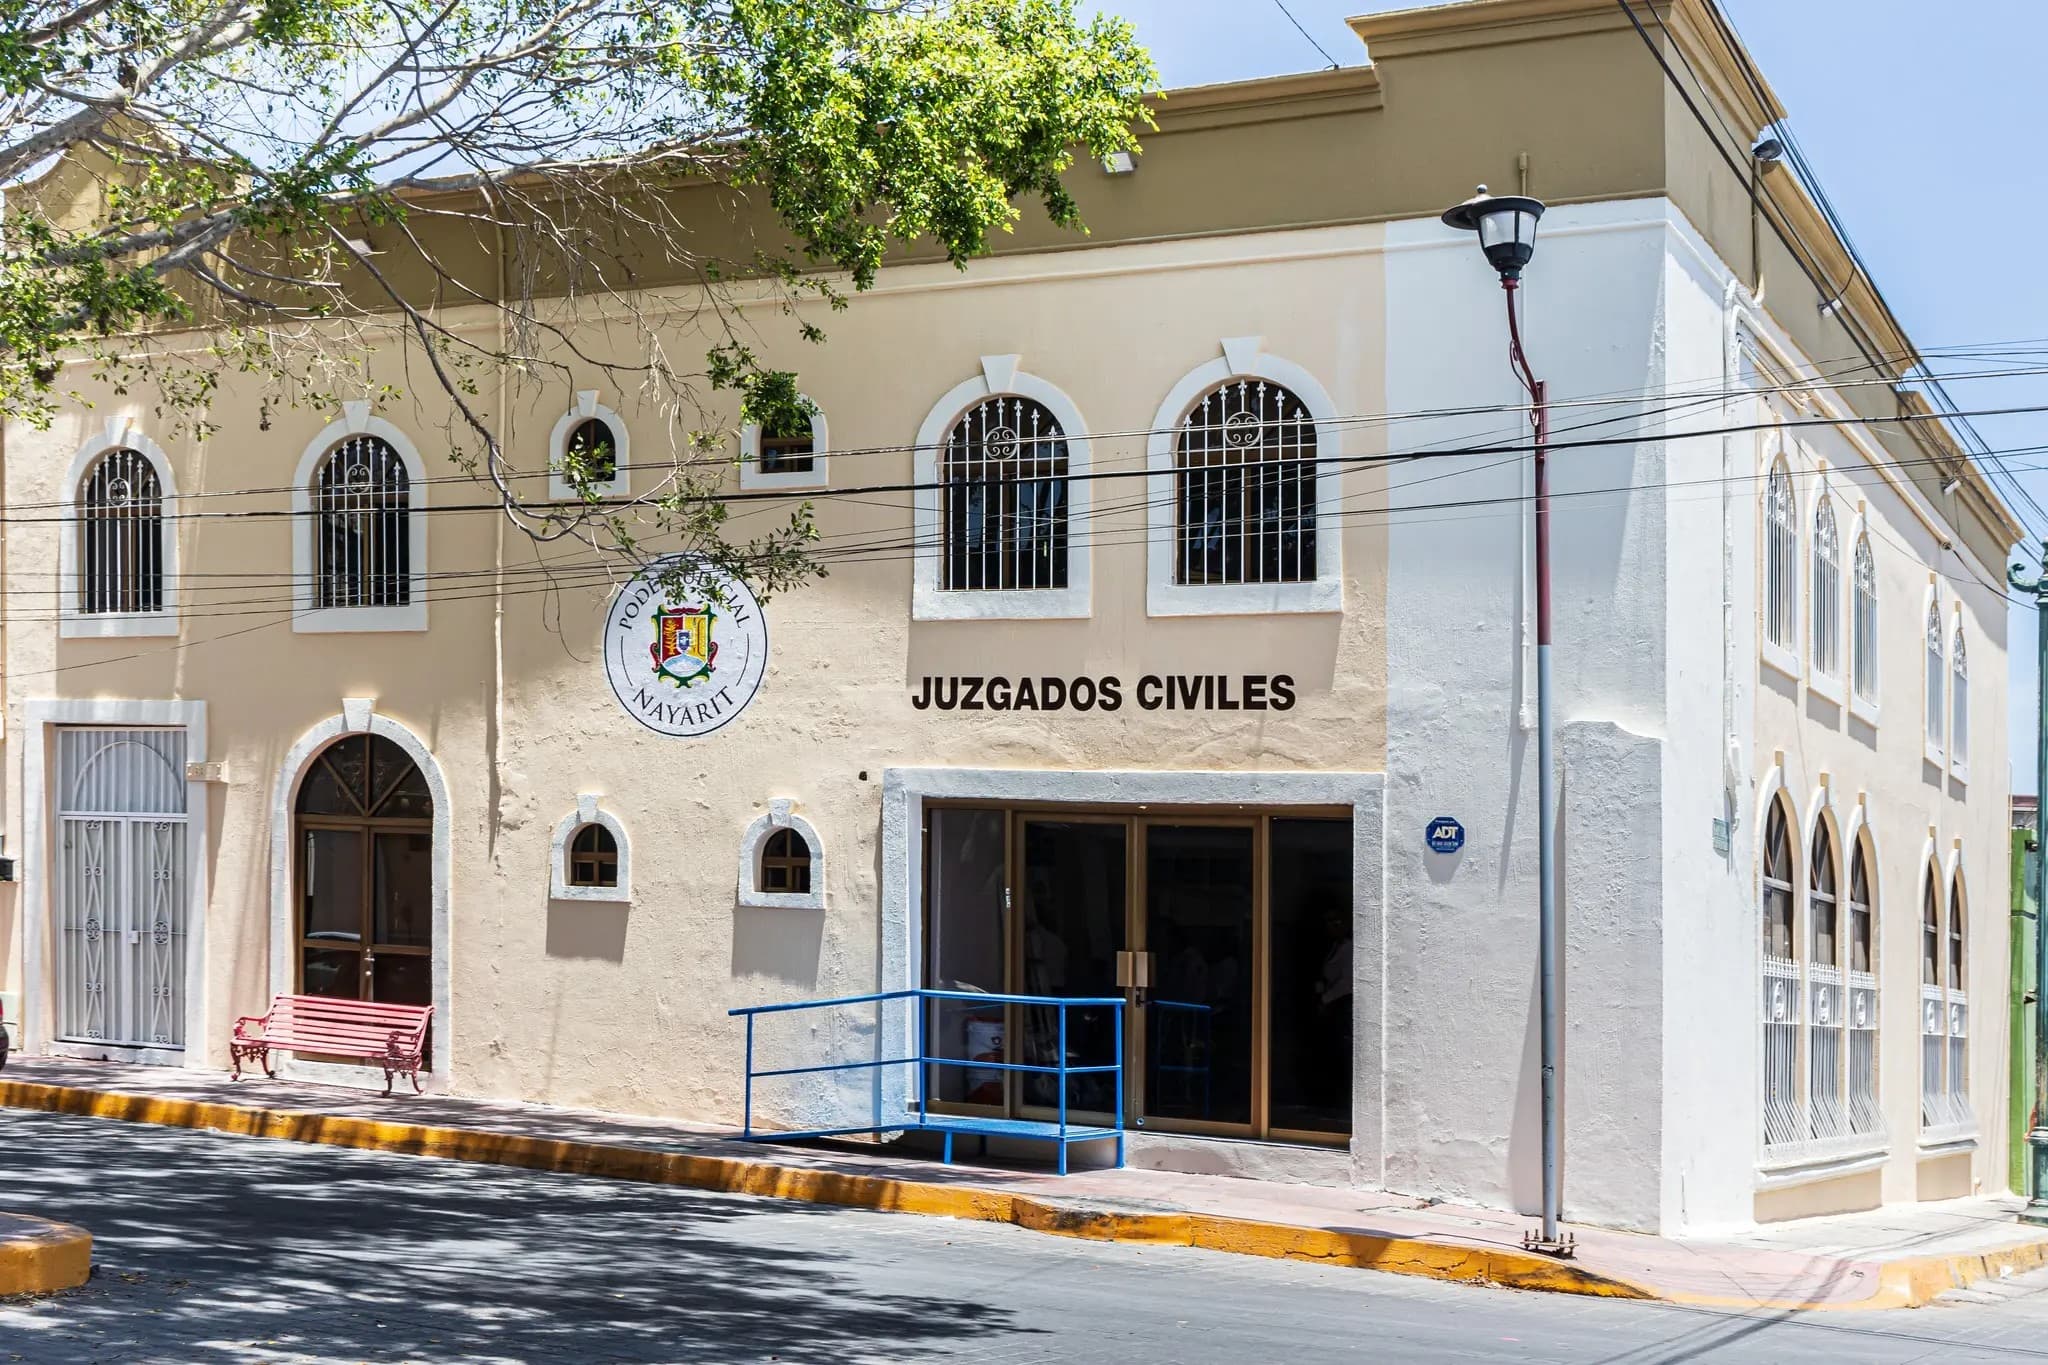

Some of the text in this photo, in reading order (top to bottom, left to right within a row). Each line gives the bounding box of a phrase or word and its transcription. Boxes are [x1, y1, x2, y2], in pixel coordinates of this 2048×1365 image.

[619, 572, 670, 630] PODE
[632, 685, 734, 726] NAYARIT
[911, 674, 1296, 712] JUZGADOS CIVILES
[1432, 826, 1458, 839] ADT
